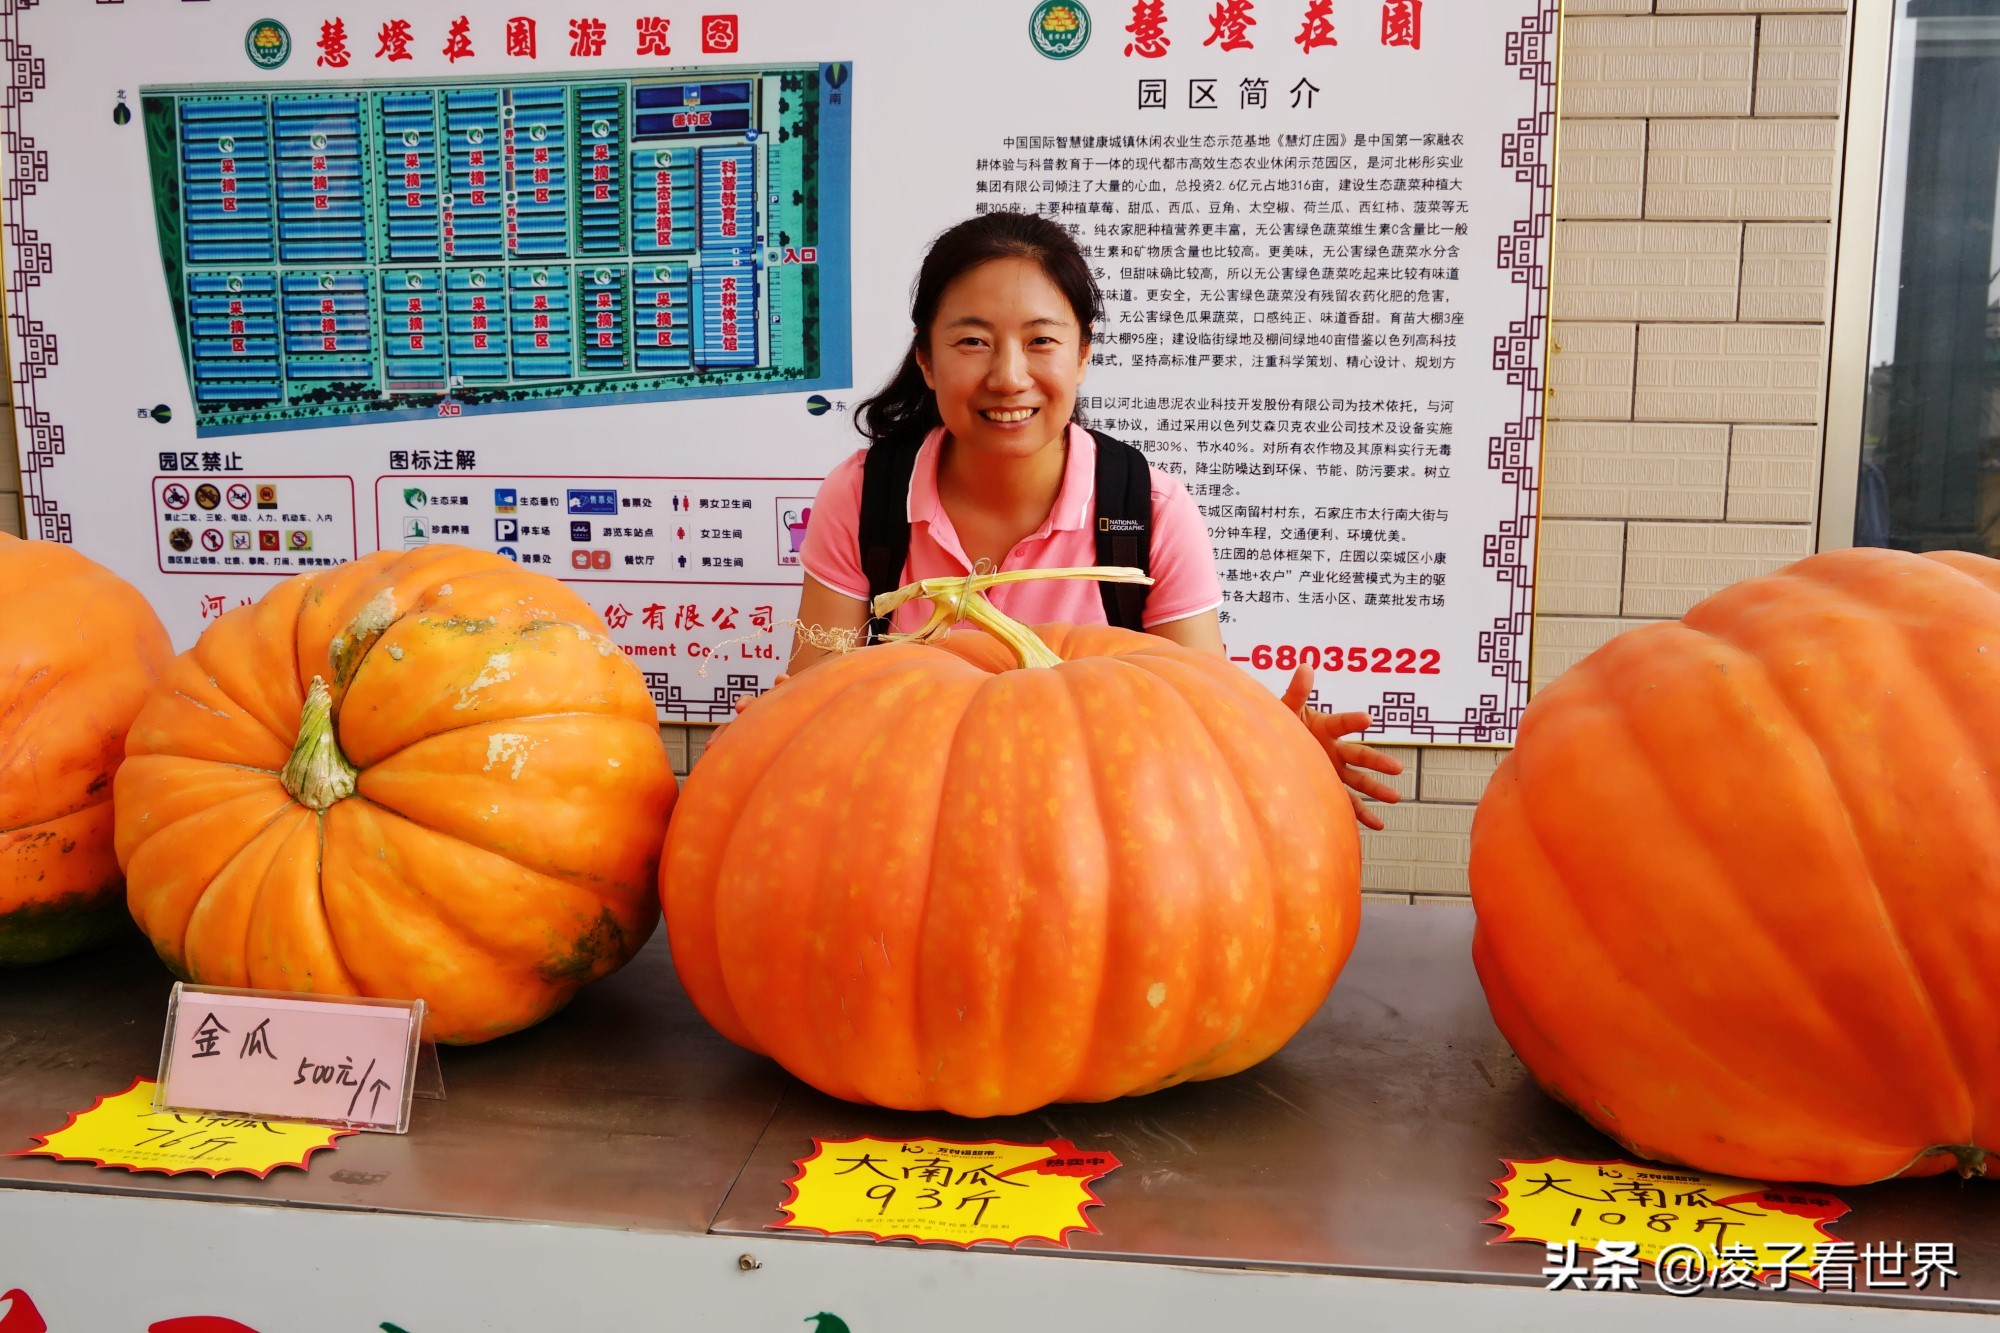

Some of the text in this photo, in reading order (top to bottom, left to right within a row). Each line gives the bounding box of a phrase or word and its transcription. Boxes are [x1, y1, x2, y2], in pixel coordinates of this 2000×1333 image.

[116, 89, 127, 100] 北
[829, 93, 841, 105] 南
[1138, 77, 1321, 110] 园区简介
[673, 112, 712, 127] 垂钓区
[404, 153, 421, 207] 采摘区
[469, 150, 485, 205] 采摘区
[534, 147, 550, 203] 采摘区
[593, 144, 610, 200] 采摘区
[221, 159, 237, 211] 采摘区
[312, 156, 329, 209] 采摘区
[721, 160, 737, 236] 科普教育馆
[656, 171, 672, 246] 生态采摘区
[1057, 223, 1468, 236] 菜。纯农家肥种植营养更丰富，无公害绿色蔬菜维生素C含量比一般
[784, 248, 816, 263] 入口
[1088, 267, 1460, 280] 多，但甜味确比较高，所以无公害绿色蔬菜吃起来比较有味道
[407, 297, 424, 350] 采摘区
[471, 296, 488, 349] 采摘区
[533, 294, 550, 348] 采摘区
[596, 292, 613, 347] 采摘区
[655, 292, 672, 346] 采摘区
[721, 277, 738, 351] 农耕体验馆
[229, 301, 246, 352] 采摘区
[321, 299, 337, 351] 采摘区
[138, 408, 148, 418] 西
[438, 404, 461, 416] 入口
[836, 401, 847, 412] 东
[1119, 440, 1452, 456] 节肥30%、节水40%。对所有农作物及其原料实行无毒
[159, 451, 244, 471] 园区禁止
[390, 450, 476, 470] 图标注解
[1149, 461, 1451, 478] 农药，降尘防噪达到环保、节能、防污要求。树立
[430, 496, 469, 506] 生态采摘
[520, 496, 559, 507] 生态垂钓
[622, 498, 652, 508] 售票处
[699, 499, 752, 510] 男女卫生间
[431, 525, 469, 535] 珍禽养殖
[521, 526, 551, 536] 停车场
[602, 527, 654, 538] 游览车站点
[700, 528, 743, 539] 女卫生间
[624, 555, 655, 565] 餐饮厅
[701, 556, 744, 567] 男卫生间
[782, 556, 800, 564] 垃圾
[1216, 569, 1446, 586] +基地+农户”产业化经营模式为主的驱
[604, 603, 774, 633] 份有限公司
[617, 643, 780, 662] pment Co., Ltd.
[1224, 644, 1441, 675] -68035222
[191, 1012, 277, 1060] 金瓜
[134, 1127, 237, 1160] 76斤
[834, 1153, 1030, 1188] 大南瓜
[1521, 1172, 1768, 1217] 大南瓜
[866, 1184, 1001, 1226] 93斤
[1571, 1207, 1746, 1258] 108斤
